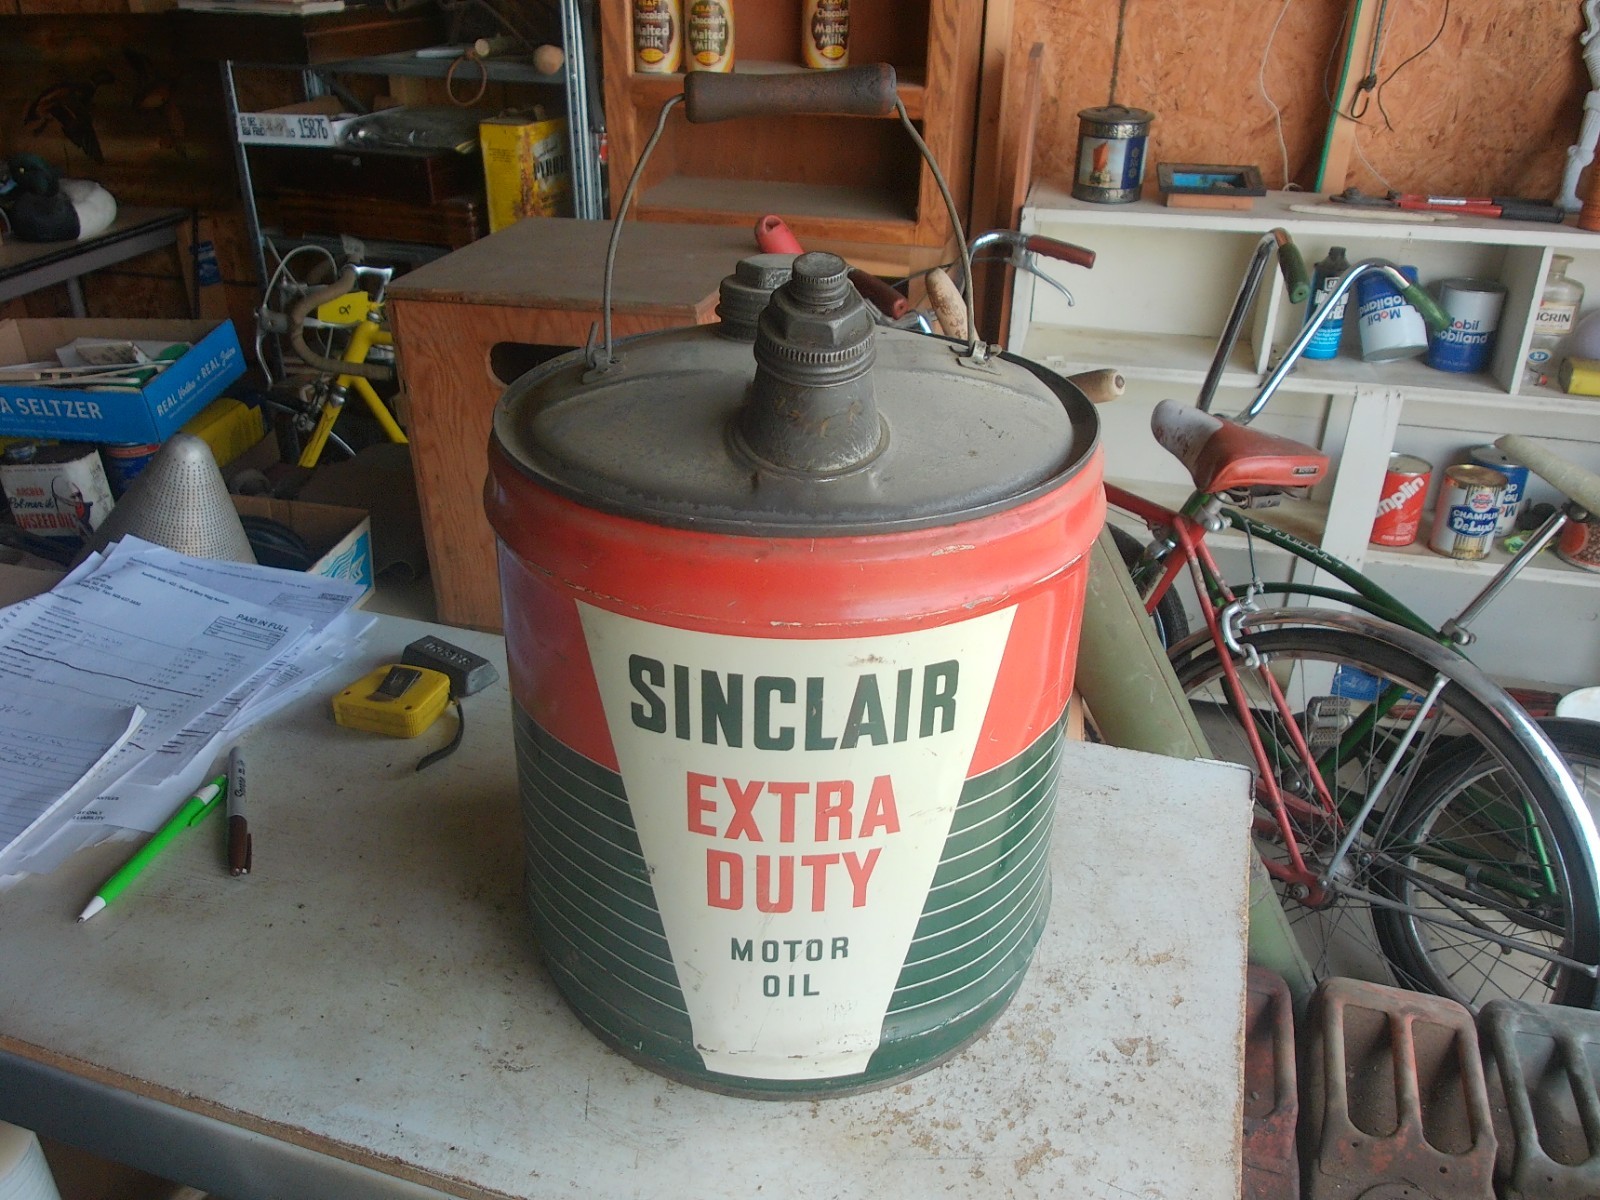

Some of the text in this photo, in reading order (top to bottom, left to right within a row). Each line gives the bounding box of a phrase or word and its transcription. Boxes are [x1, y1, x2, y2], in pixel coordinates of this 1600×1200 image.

[638, 35, 663, 47] Milk
[691, 25, 726, 40] Malted
[821, 34, 845, 44] Milk
[695, 39, 720, 50] Milk
[1368, 308, 1401, 326] Mobil
[1536, 312, 1571, 323] ICRIN
[156, 393, 178, 417] REAL
[200, 356, 220, 379] REAL
[16, 397, 103, 420] SELTZER
[1453, 508, 1499, 521] CHAMPLIN
[236, 613, 258, 625] PAID
[258, 618, 268, 628] IN
[267, 621, 289, 633] FULL
[628, 653, 960, 752] SINCLAIR
[686, 771, 901, 843] EXTRA
[706, 847, 883, 914] DUTY
[731, 936, 850, 963] MOTOR
[763, 974, 820, 998] OIL
